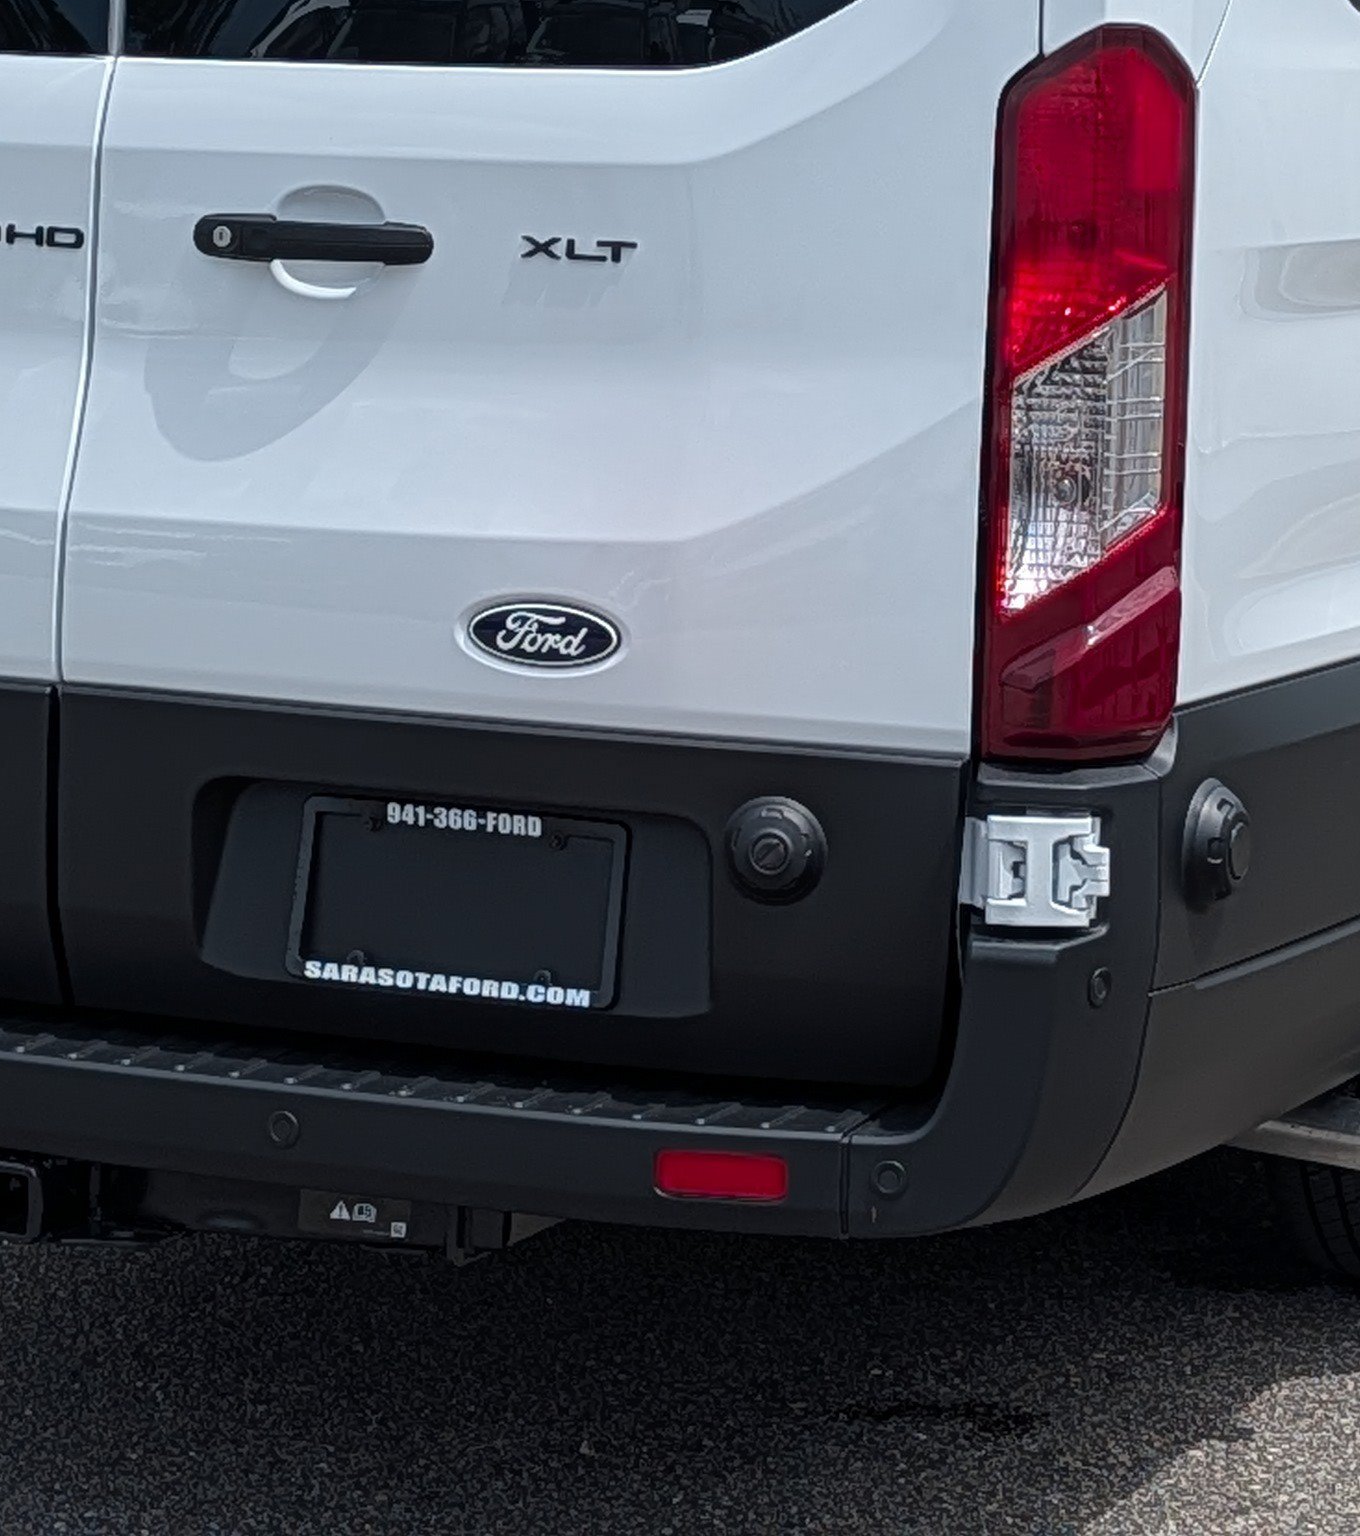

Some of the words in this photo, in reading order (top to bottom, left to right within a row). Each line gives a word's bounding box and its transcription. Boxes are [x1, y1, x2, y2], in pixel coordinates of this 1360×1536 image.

[520, 235, 638, 264] XLT
[496, 611, 588, 656] Ford
[386, 801, 542, 838] 941-366-FORD
[303, 960, 591, 1008] SARASOTAFORD.COM
